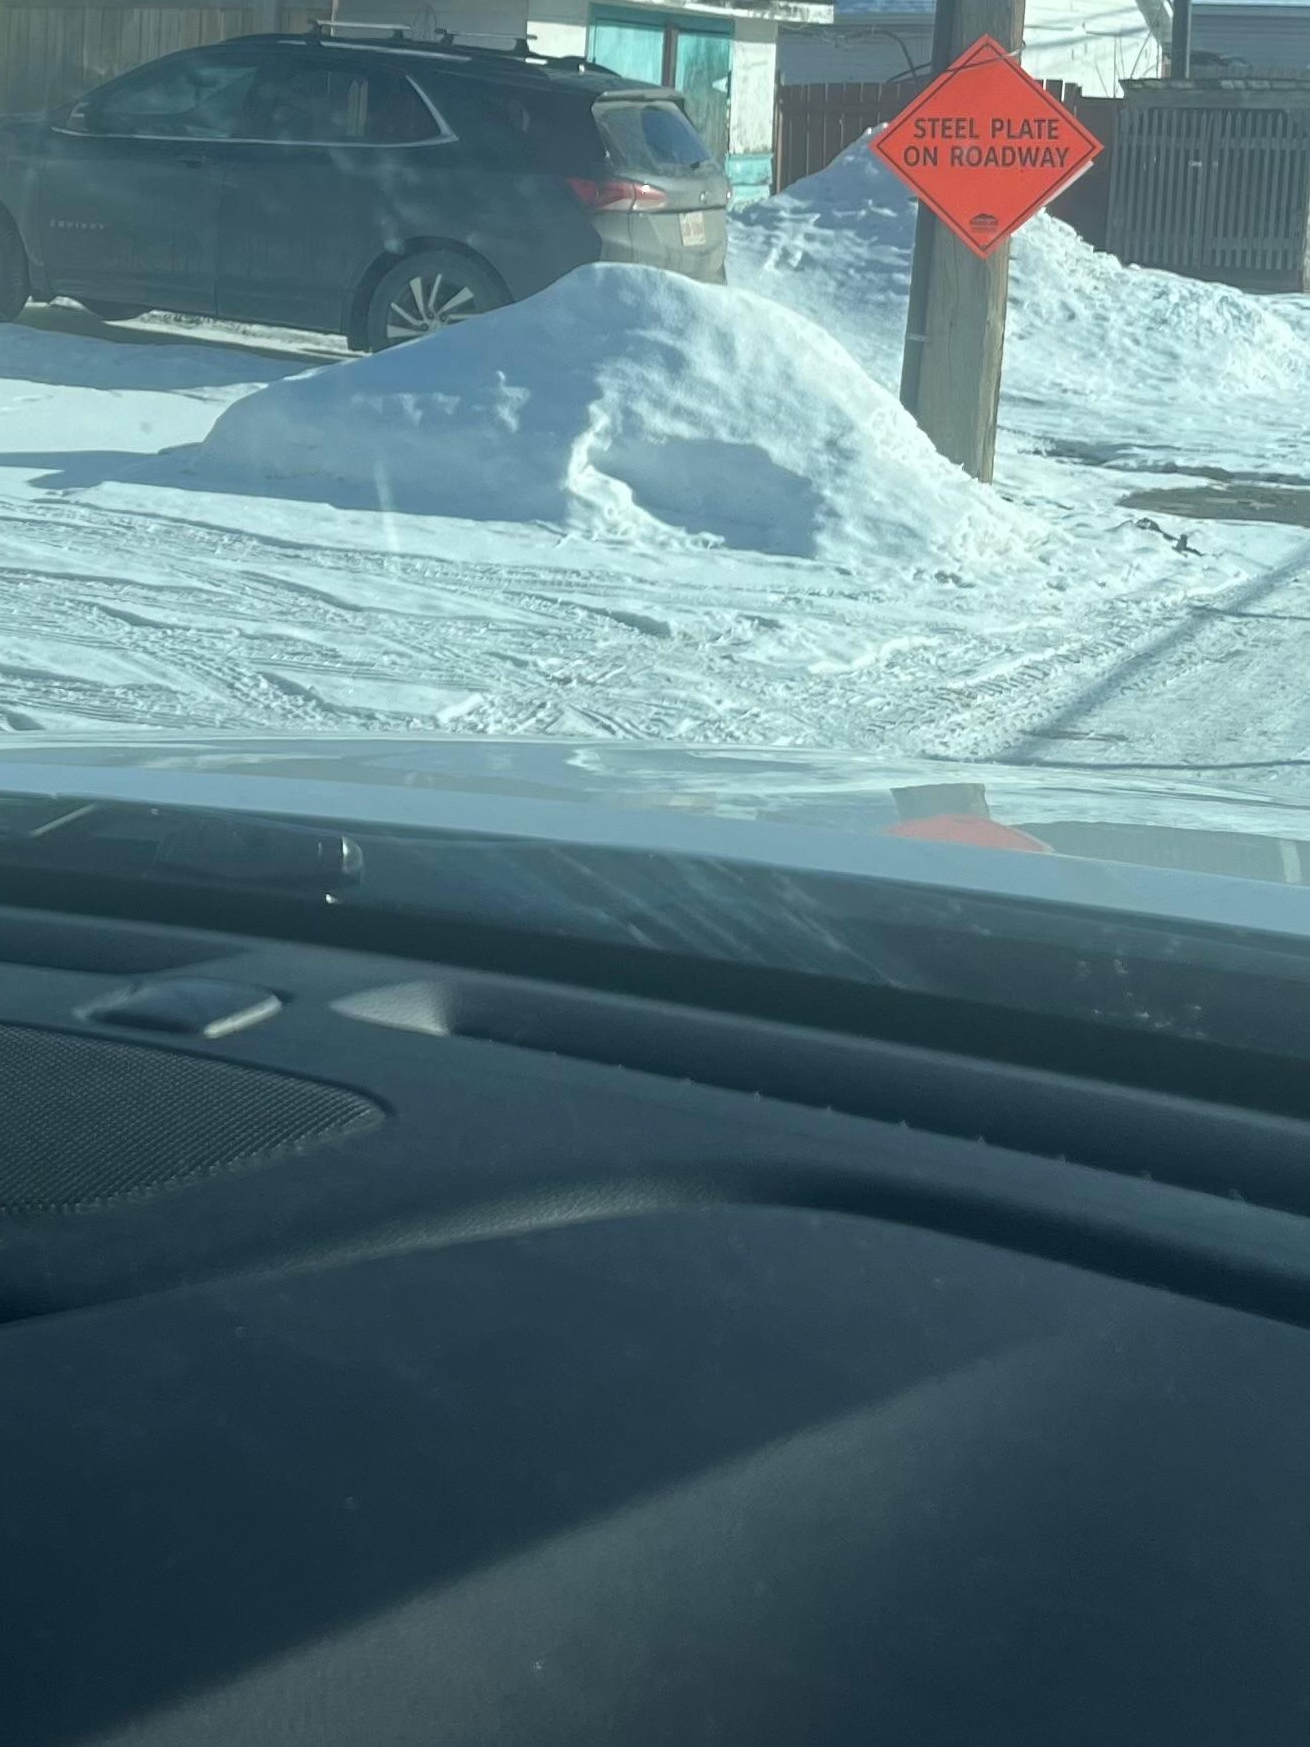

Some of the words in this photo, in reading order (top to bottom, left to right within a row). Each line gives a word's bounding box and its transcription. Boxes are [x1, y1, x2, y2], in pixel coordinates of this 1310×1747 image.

[913, 118, 979, 139] STEEL
[991, 118, 1060, 140] PLATE
[903, 145, 938, 167] ON
[950, 146, 1070, 168] ROADWAY
